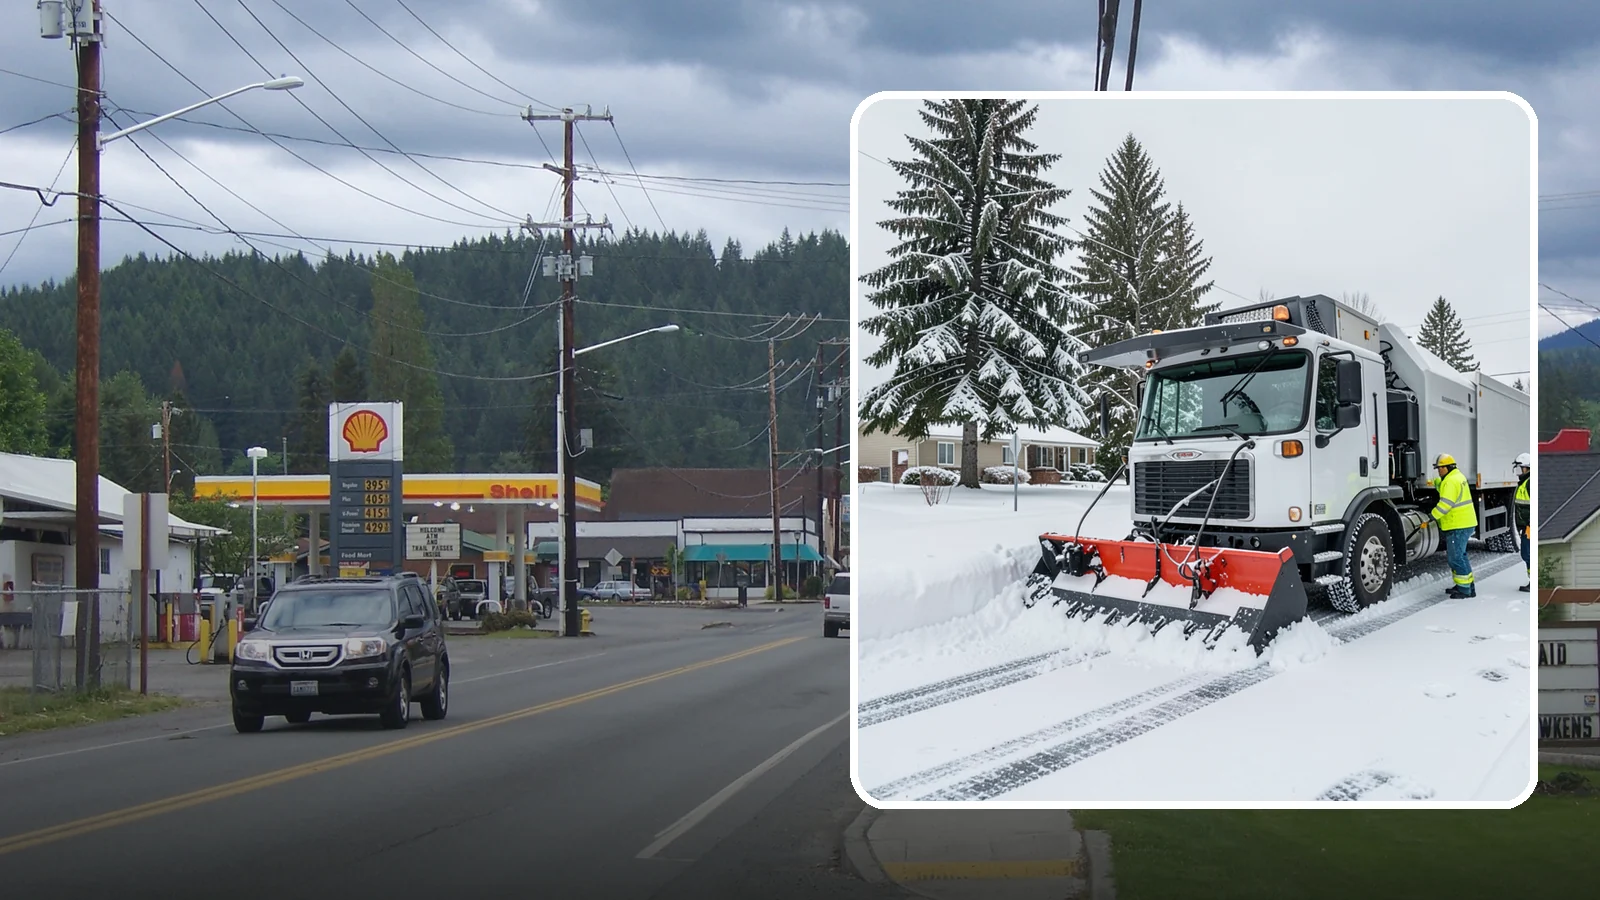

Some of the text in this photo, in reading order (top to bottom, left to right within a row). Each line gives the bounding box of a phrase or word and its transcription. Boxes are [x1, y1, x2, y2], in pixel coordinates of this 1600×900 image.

[365, 480, 384, 490] 395
[490, 484, 547, 499] Shell
[365, 494, 384, 504] 405
[365, 507, 384, 518] 415
[365, 522, 384, 533] 429
